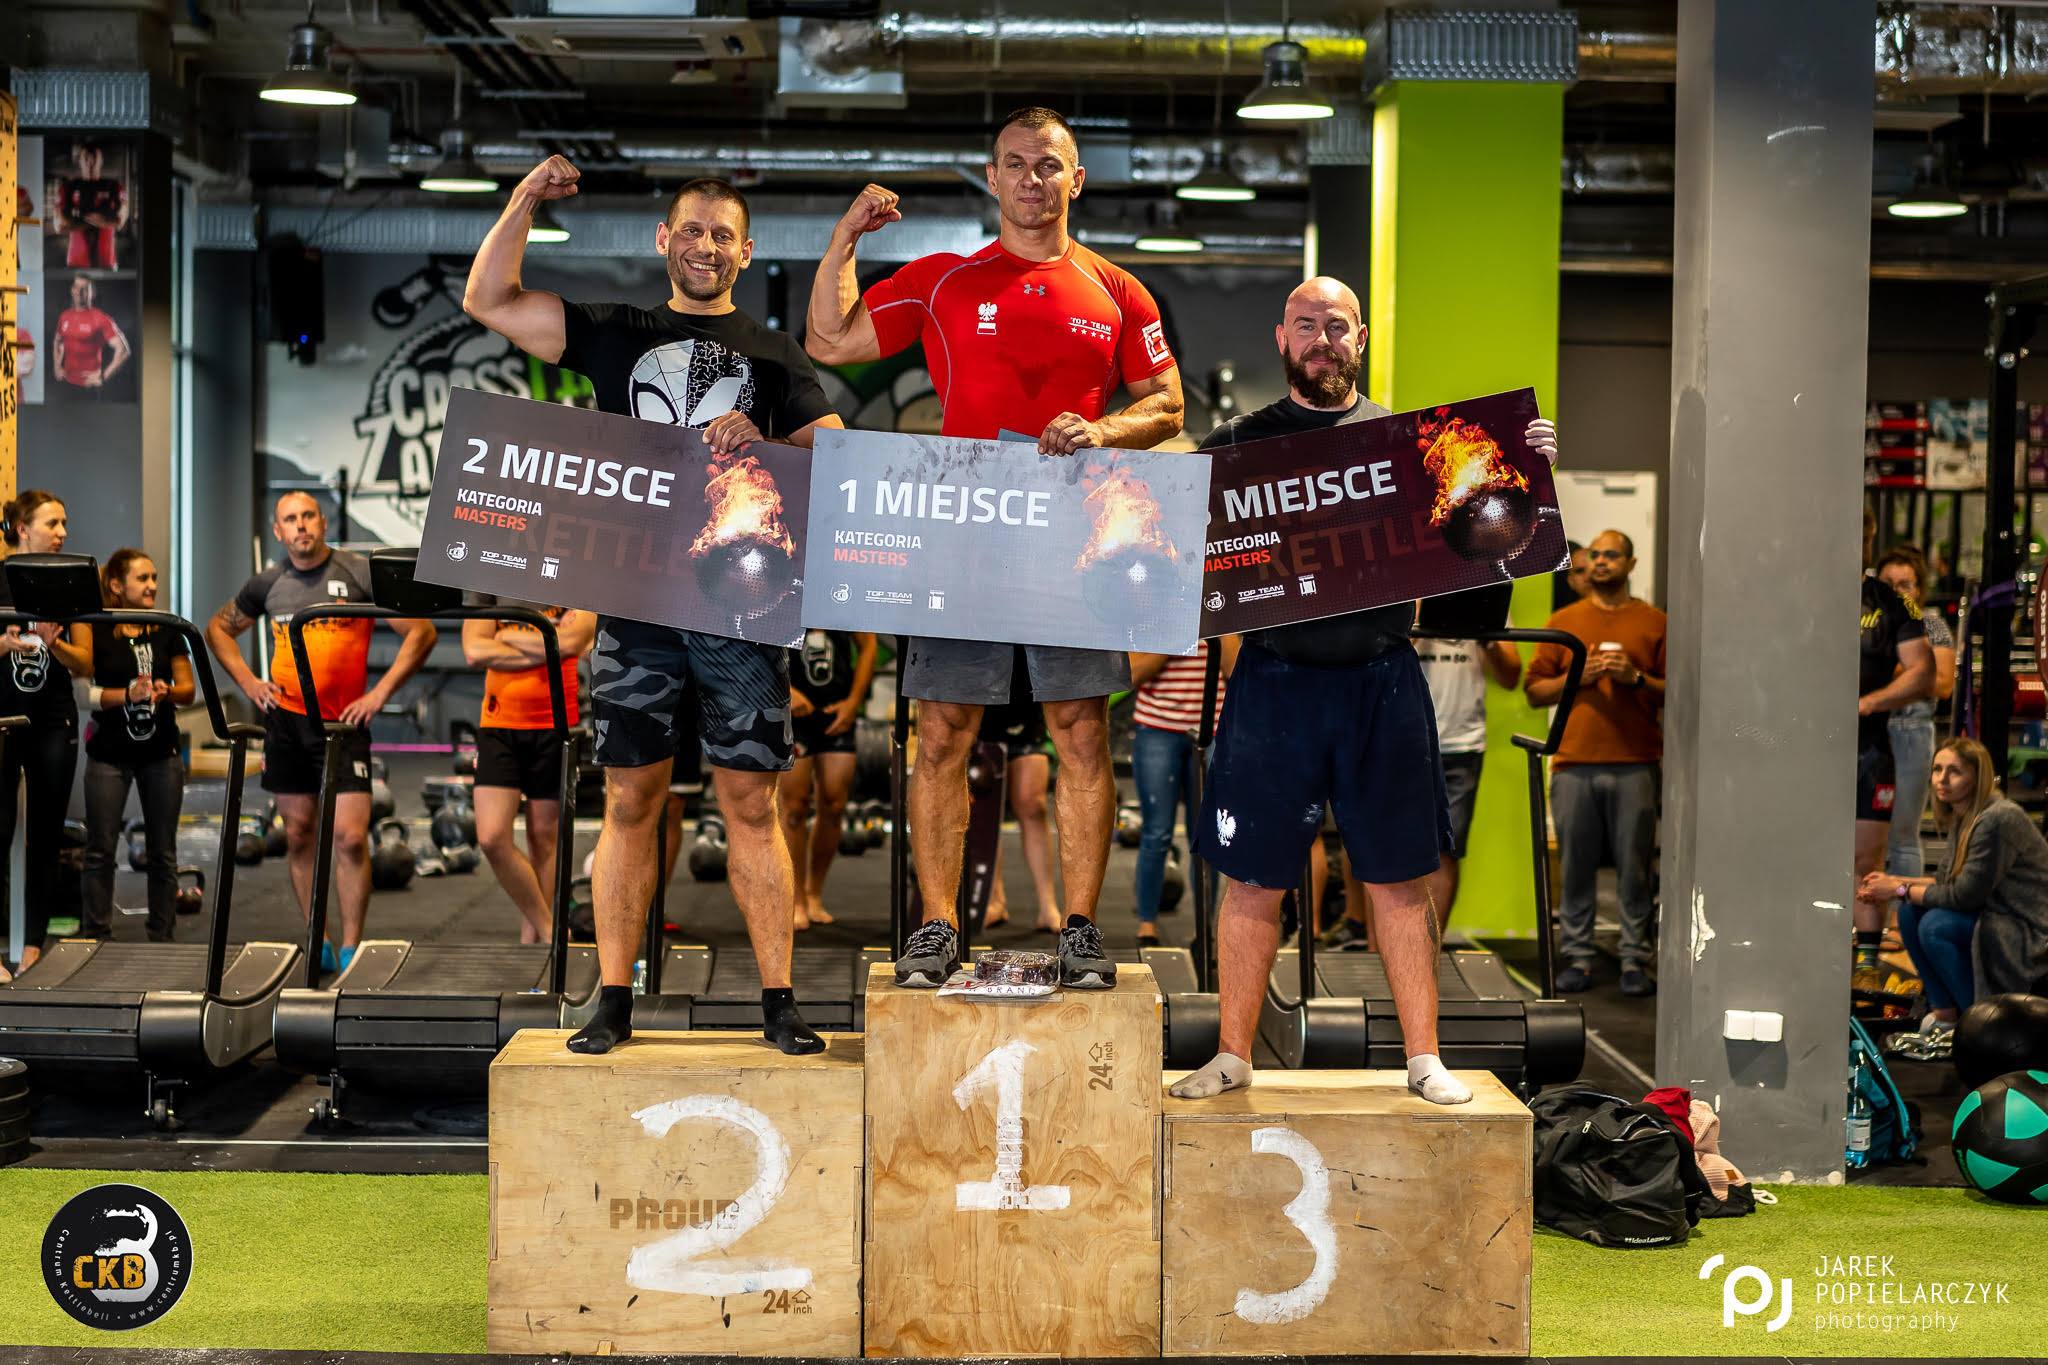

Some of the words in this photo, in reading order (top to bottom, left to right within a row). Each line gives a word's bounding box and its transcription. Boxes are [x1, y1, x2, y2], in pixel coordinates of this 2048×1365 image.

[1070, 317, 1088, 325] TOP
[1090, 321, 1112, 333] TEAM
[462, 438, 489, 475] 2
[500, 443, 676, 507] MIEJSCE
[457, 488, 543, 516] KATEGORIA
[838, 479, 858, 513] 1
[875, 480, 1051, 527] MIEJSCE
[1223, 460, 1397, 523] MIEJSCE
[454, 506, 528, 532] MASTERS
[834, 530, 922, 549] KATEGORIA
[1204, 531, 1281, 556] ATEGORIA
[481, 550, 500, 559] TOP
[501, 554, 527, 564] TEAM
[833, 547, 909, 567] MASTERS
[886, 591, 913, 599] TEAM
[1238, 589, 1256, 597] TOP
[1258, 585, 1284, 594] TEAM
[1088, 1063, 1113, 1091] 24
[1103, 1041, 1113, 1061] inch
[952, 1039, 1071, 1212] 1
[626, 1093, 815, 1297] 2
[1234, 1127, 1339, 1324] 3
[762, 1289, 791, 1314] 24
[793, 1304, 813, 1314] inch
